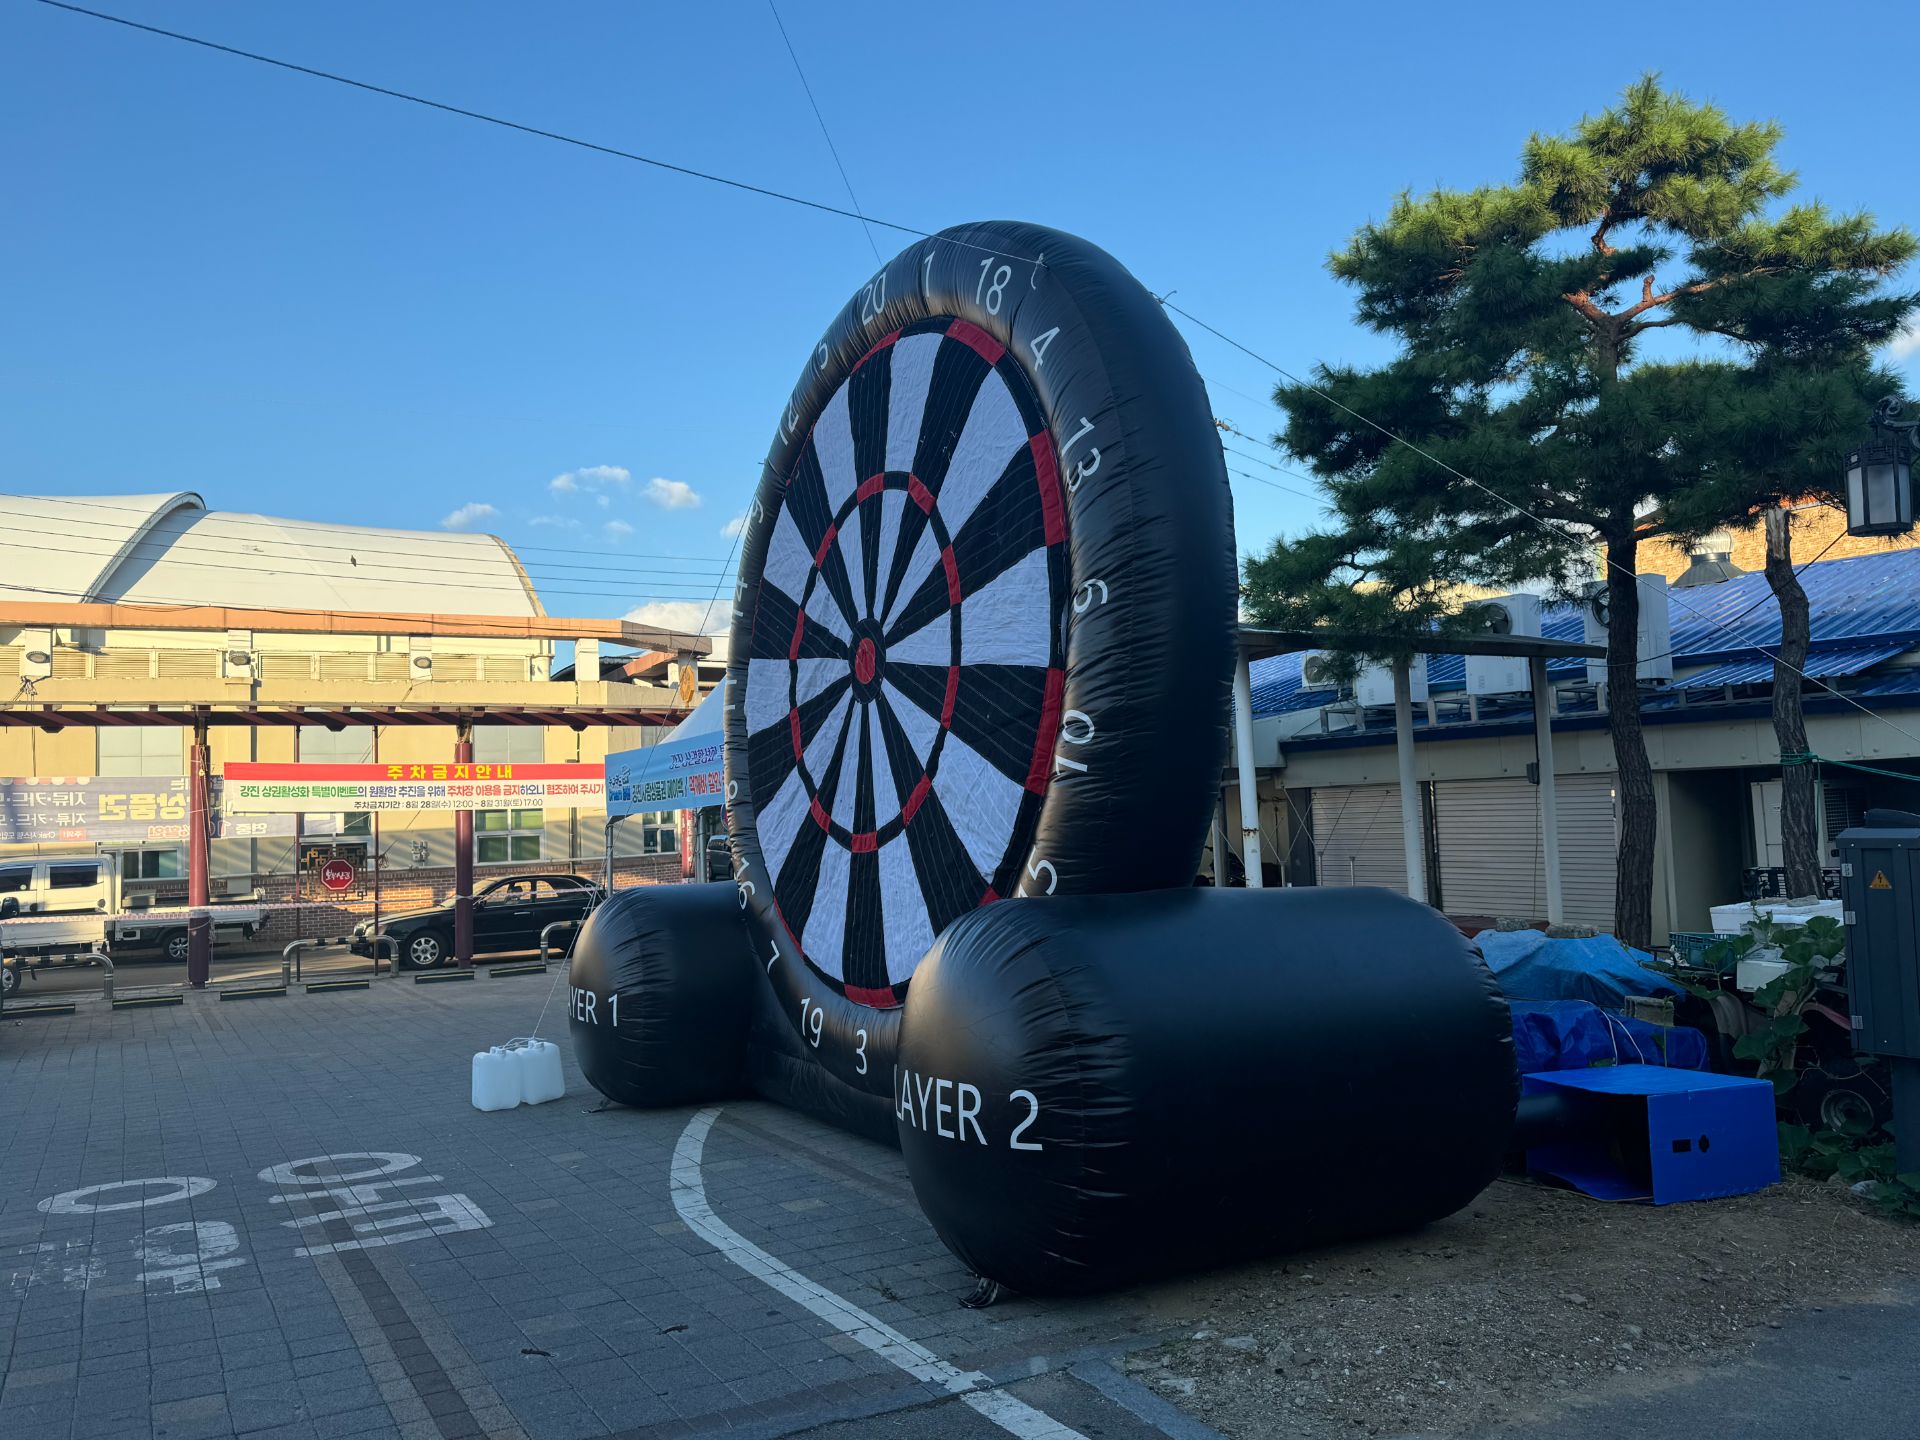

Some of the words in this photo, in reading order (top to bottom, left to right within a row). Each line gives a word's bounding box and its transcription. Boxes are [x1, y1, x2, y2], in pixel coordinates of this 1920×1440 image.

[923, 251, 936, 298] 1
[975, 256, 1012, 316] 18
[861, 272, 887, 326] 20
[1029, 326, 1060, 372] 4
[1061, 416, 1101, 493] 13
[1073, 578, 1108, 614] 6
[1055, 709, 1095, 776] 10
[239, 785, 260, 798] 강진
[261, 785, 310, 798] 상권활성화
[369, 785, 397, 798] 원활한
[398, 785, 426, 798] 추진을
[427, 785, 445, 798] 위해
[447, 784, 474, 797] 주차장
[475, 784, 501, 796] 이용을
[503, 784, 545, 796] 금지하오니
[767, 939, 780, 974] 7
[568, 984, 598, 1025] YER
[608, 993, 618, 1027] 1
[801, 997, 824, 1049] 19
[855, 1028, 868, 1075] 3
[893, 1063, 989, 1146] LAYER
[1009, 1089, 1044, 1151] 2
